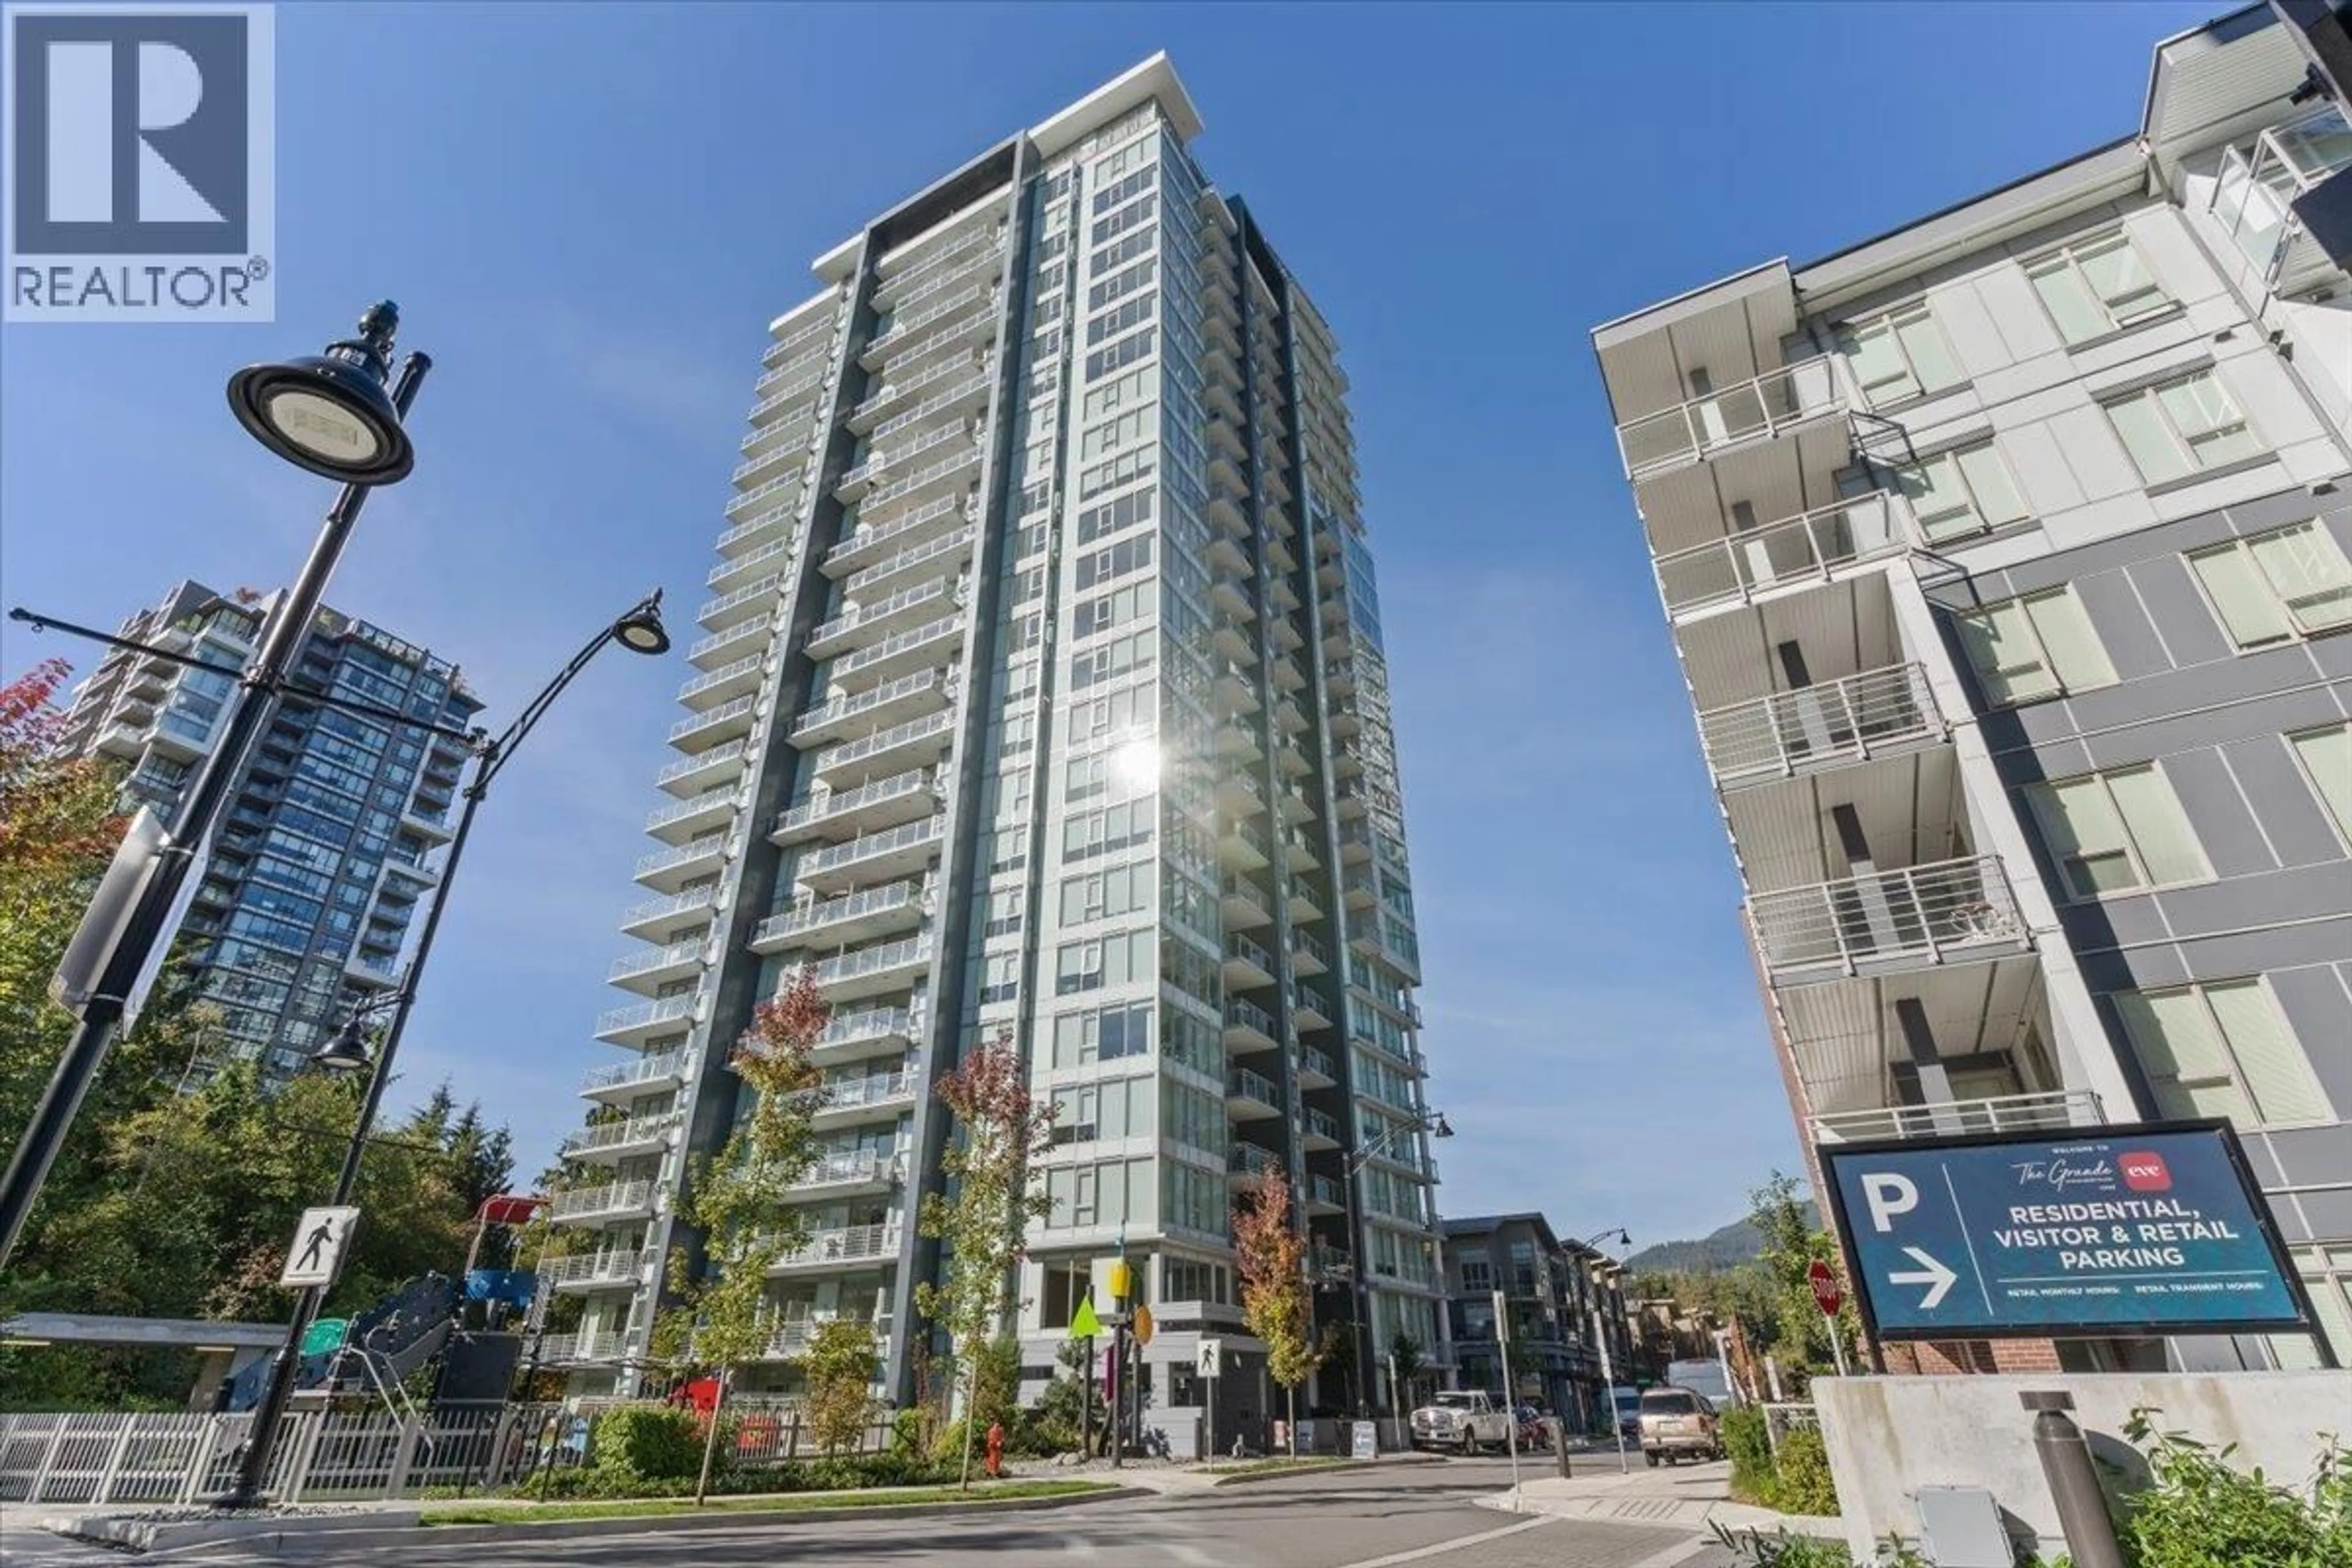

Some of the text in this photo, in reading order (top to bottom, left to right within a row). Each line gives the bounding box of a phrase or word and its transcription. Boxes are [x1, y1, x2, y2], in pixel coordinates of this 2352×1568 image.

[2011, 1158, 2113, 1192] The Grande
[1861, 1173, 1918, 1232] P
[2009, 1199, 2199, 1224] RESIDENTIAL,
[1993, 1221, 2239, 1248] VISITOR & RETAIL
[2060, 1247, 2185, 1269] PARKING
[1812, 1277, 1838, 1299] STOP
